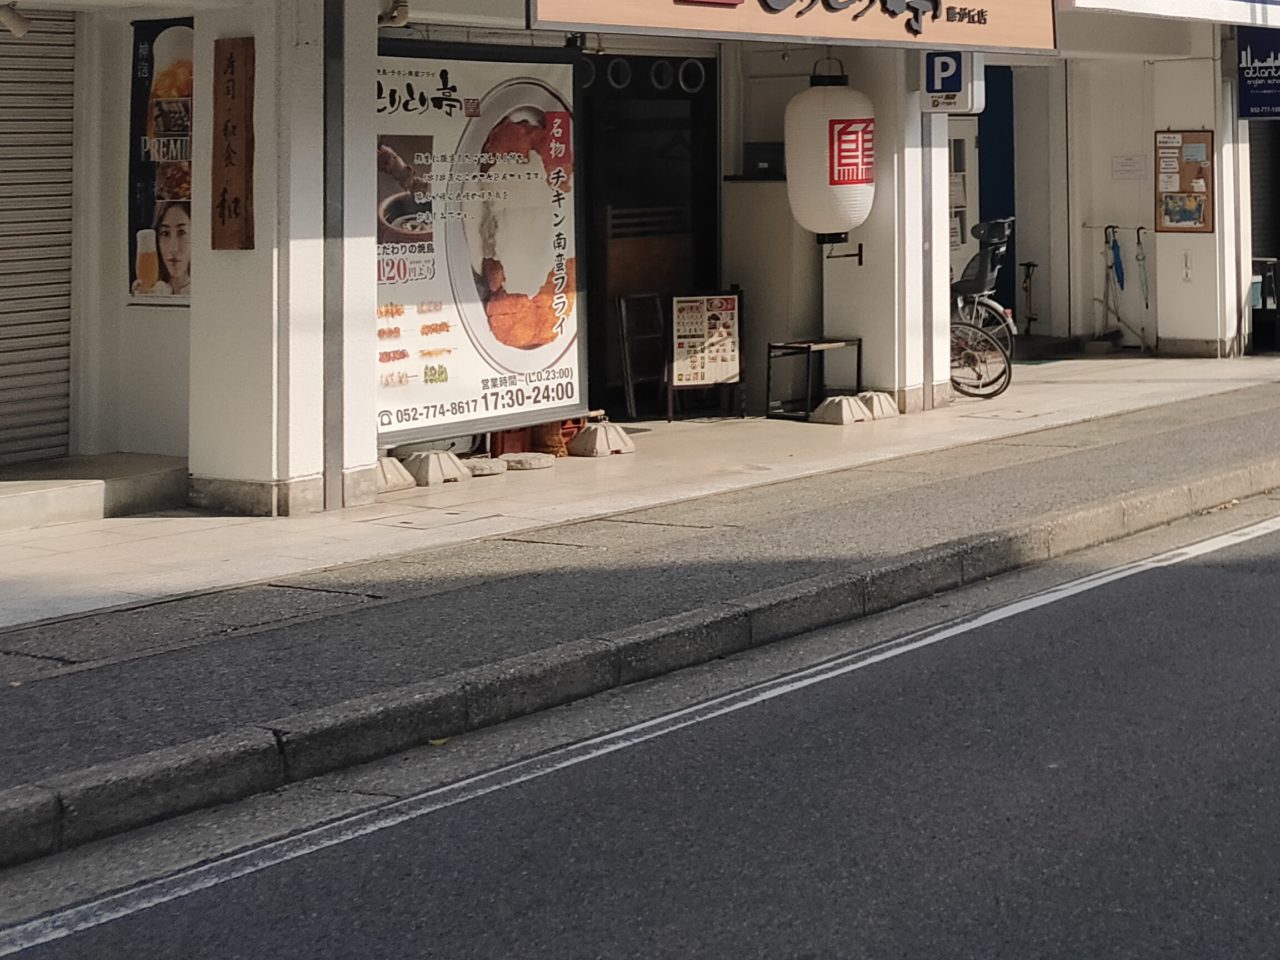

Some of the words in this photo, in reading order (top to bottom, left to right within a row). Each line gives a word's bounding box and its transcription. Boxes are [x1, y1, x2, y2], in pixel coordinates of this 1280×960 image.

[934, 56, 957, 90] P
[549, 118, 566, 158] 名物
[550, 168, 568, 335] チキン南蛮フライ
[481, 375, 518, 391] 営業時間
[481, 381, 575, 411] 17:30-24:00
[396, 399, 478, 423] 052-774-8617
